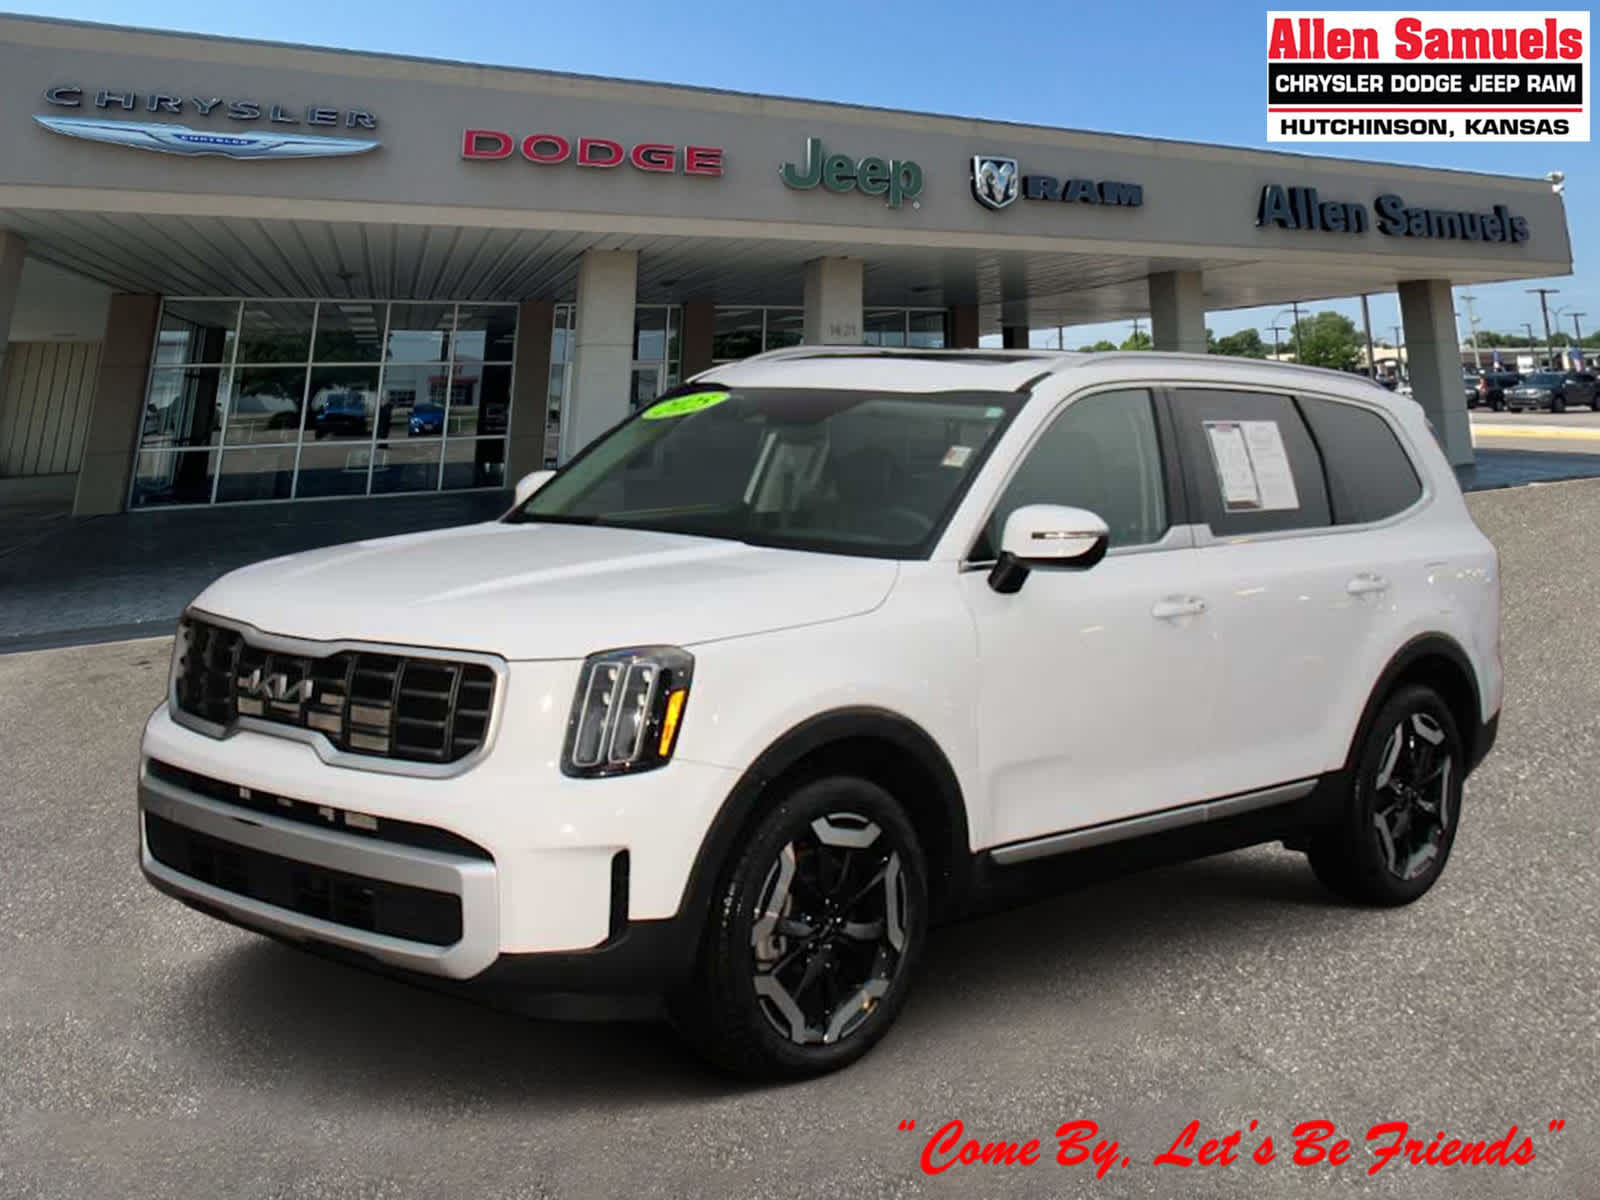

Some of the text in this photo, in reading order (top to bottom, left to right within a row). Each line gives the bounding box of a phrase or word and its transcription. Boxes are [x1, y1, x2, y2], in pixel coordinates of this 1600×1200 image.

[43, 87, 377, 129] CHRYSLER
[462, 128, 724, 177] DODGE
[782, 136, 924, 209] Jeep
[1022, 175, 1144, 208] RAM
[1255, 183, 1531, 243] Allen Samuels
